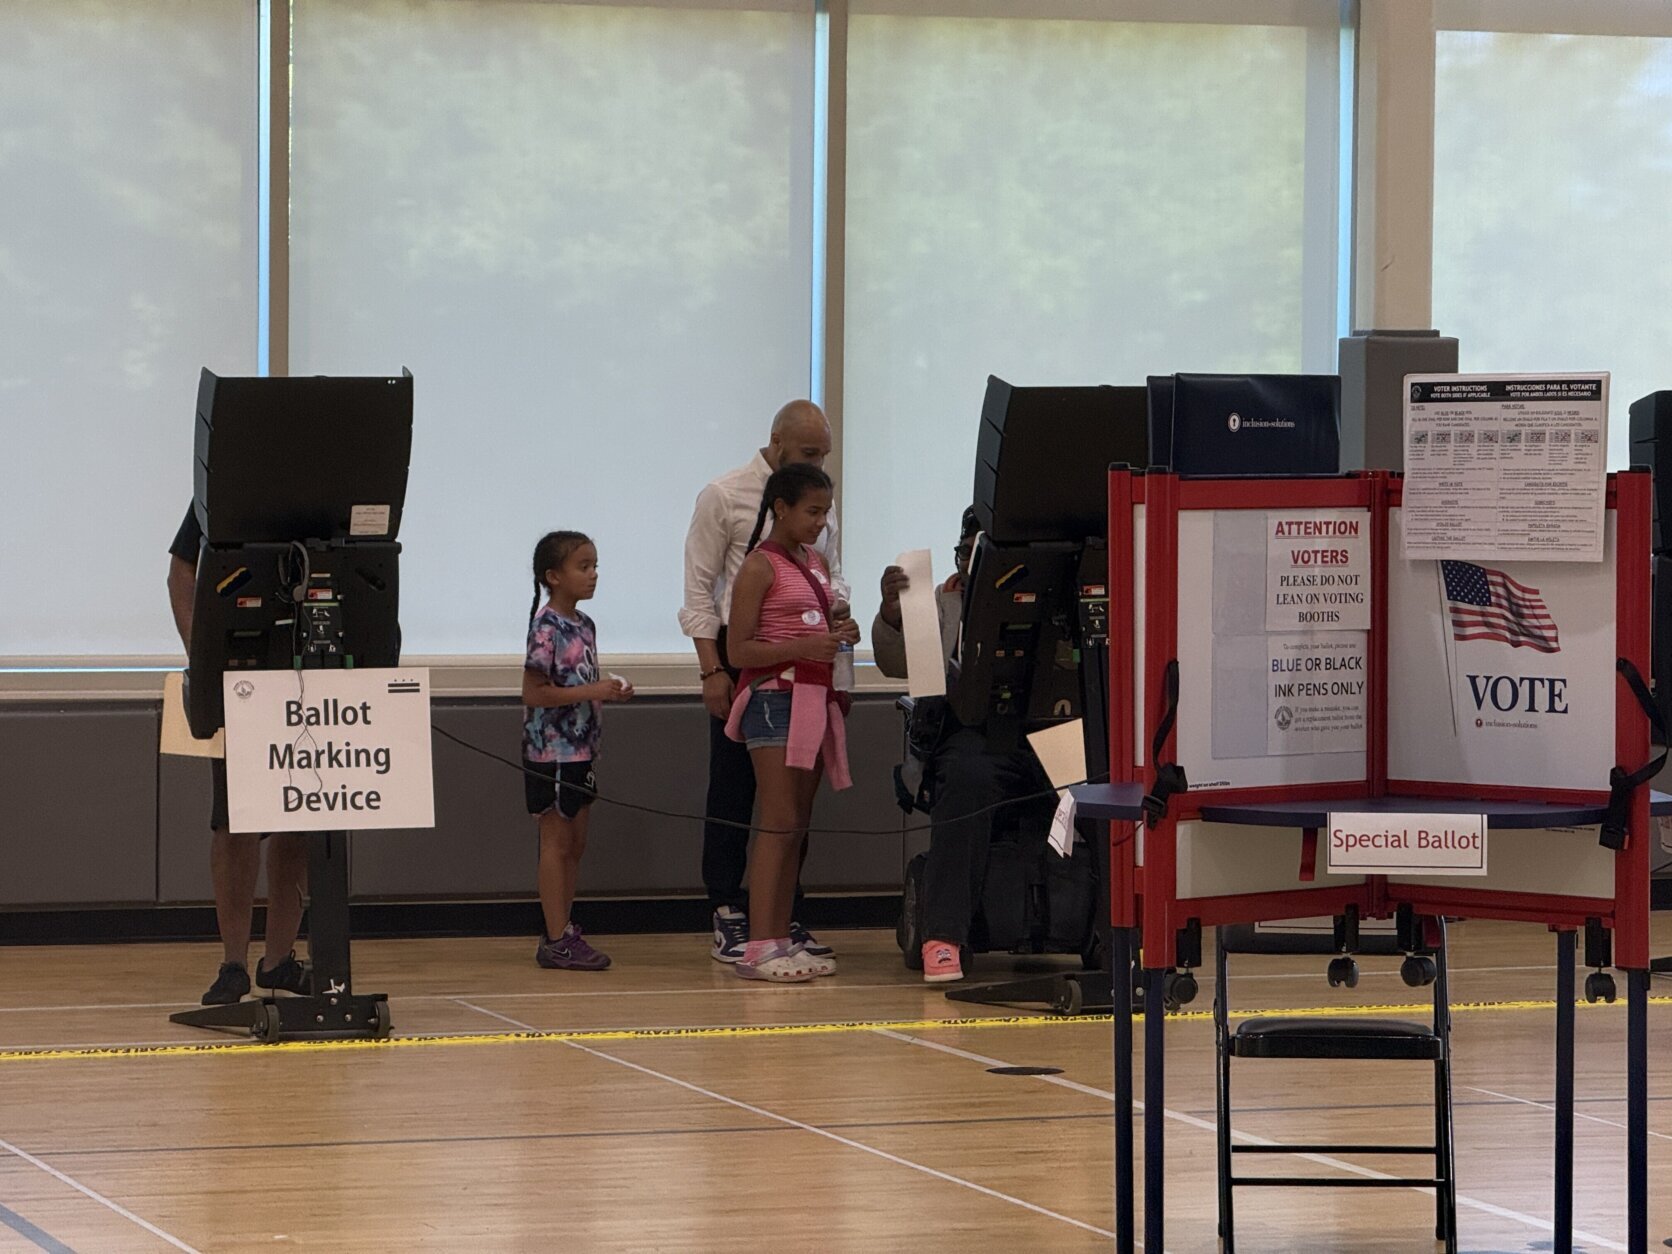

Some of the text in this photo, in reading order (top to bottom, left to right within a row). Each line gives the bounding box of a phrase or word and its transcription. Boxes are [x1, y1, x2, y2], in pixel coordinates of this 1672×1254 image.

[1275, 520, 1359, 536] ATTENTION
[1291, 549, 1349, 564] VOTERS
[1280, 574, 1360, 587] PLEASE DO NOT
[1276, 592, 1364, 605] LEAN ON VOTING
[1298, 611, 1340, 623] BOOTHS
[1272, 656, 1362, 672] BLUE OR BLACK
[1274, 681, 1364, 697] INK PENS ONLY
[1466, 674, 1568, 714] VOTE
[285, 698, 372, 727] Ballot
[269, 742, 390, 775] Marking
[282, 784, 381, 813] Device
[1333, 829, 1480, 852] Special Ballot
